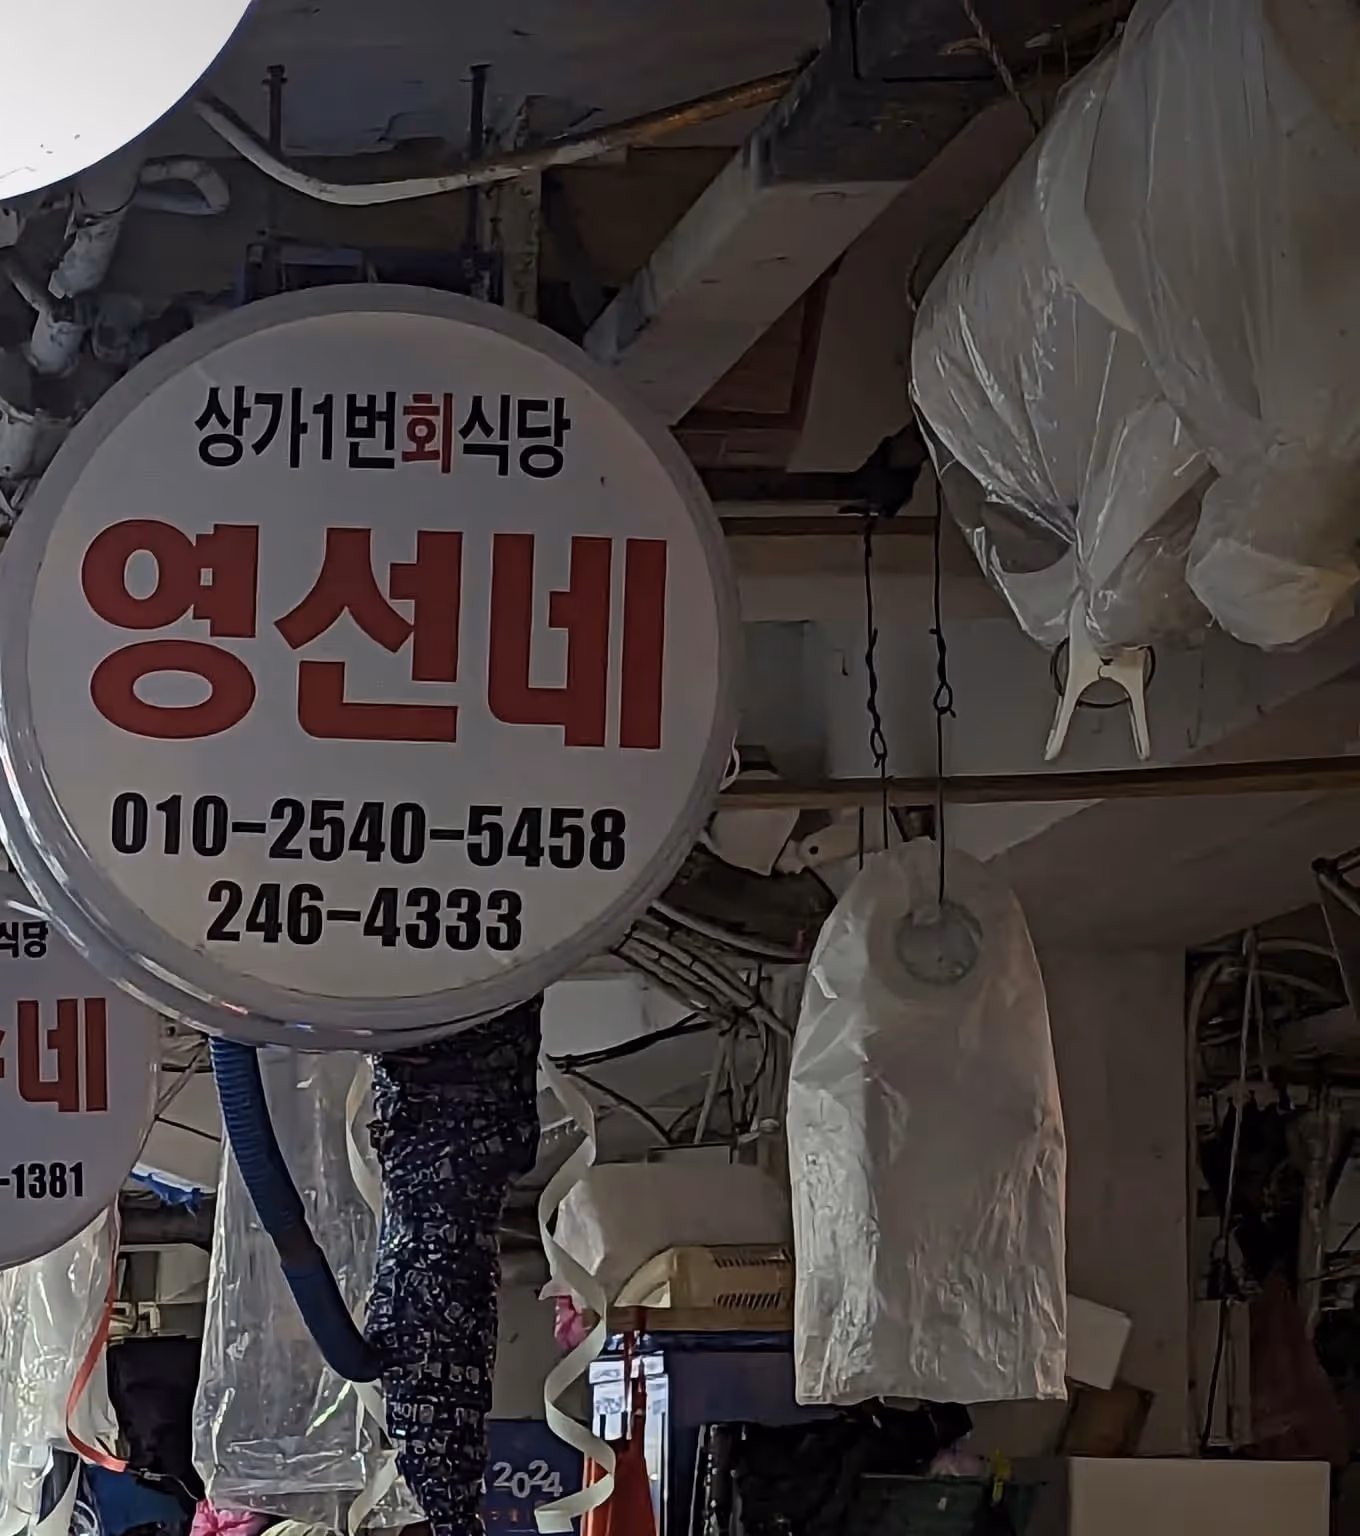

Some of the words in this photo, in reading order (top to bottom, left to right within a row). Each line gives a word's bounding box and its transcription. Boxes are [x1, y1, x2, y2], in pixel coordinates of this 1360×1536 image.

[194, 384, 571, 478] 상가1번회식당
[81, 517, 668, 750] 영선네
[111, 792, 627, 872] 010-2540-5458
[206, 883, 524, 952] 246-4333
[492, 1460, 563, 1498] 2024
